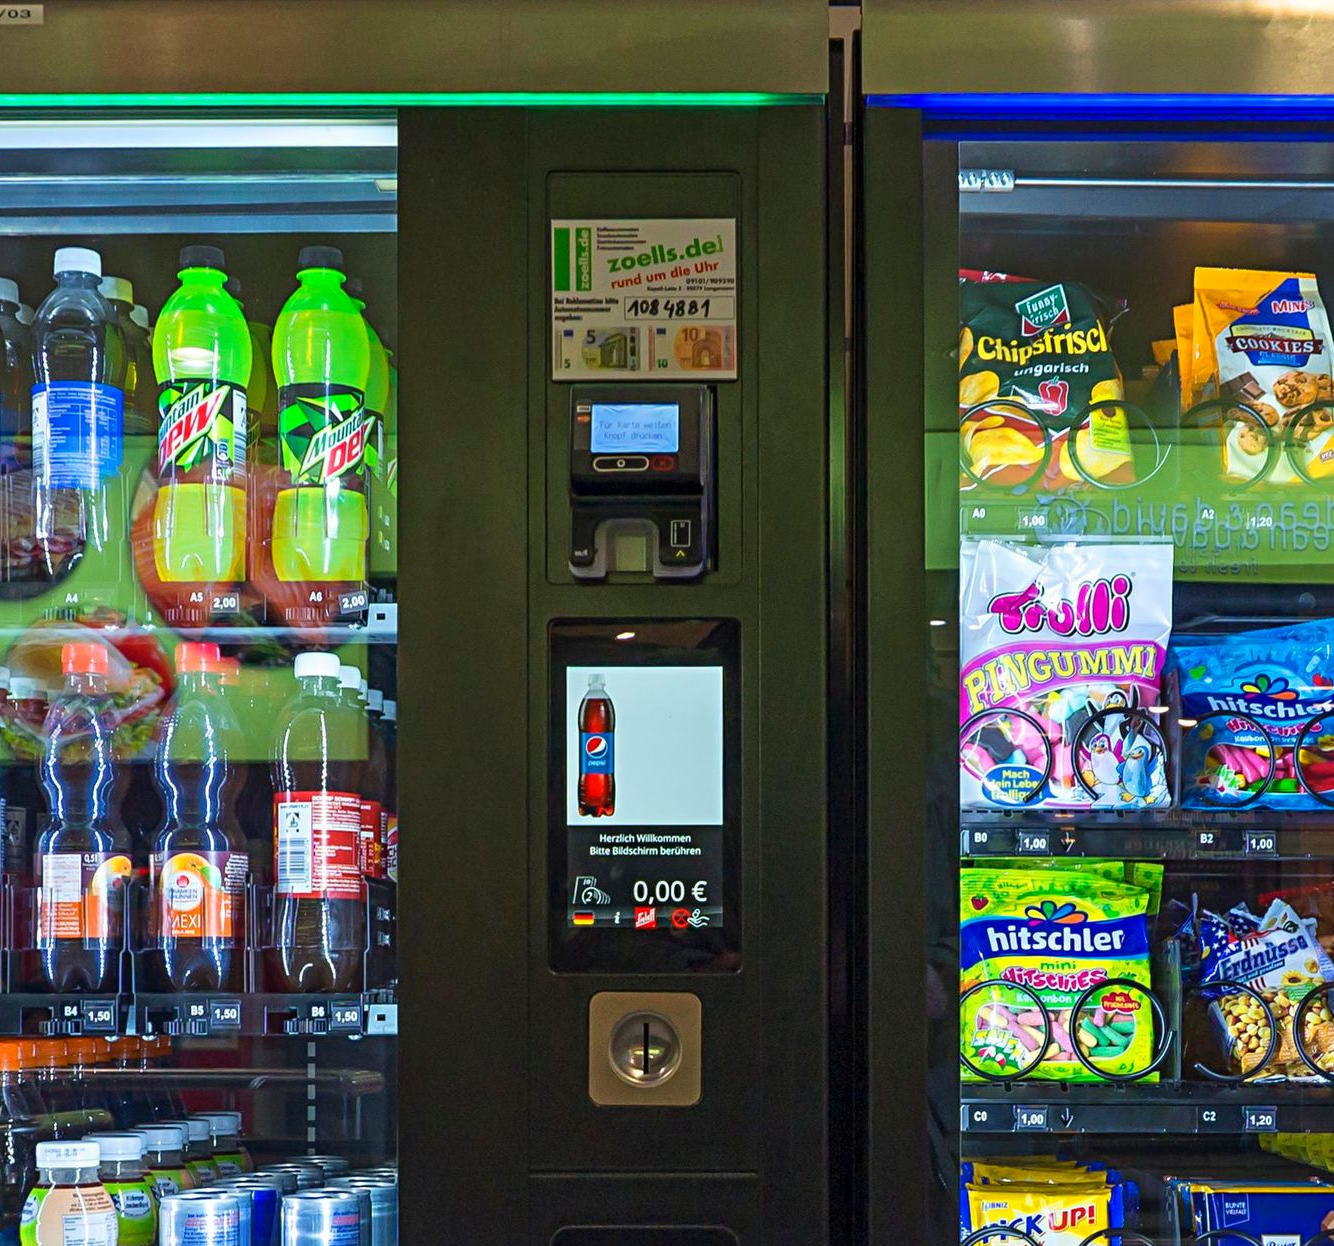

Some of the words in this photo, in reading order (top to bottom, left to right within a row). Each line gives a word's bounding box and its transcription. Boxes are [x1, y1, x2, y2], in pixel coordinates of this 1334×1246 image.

[607, 237, 718, 273] zoells.de
[611, 272, 642, 290] rund
[646, 270, 667, 282] um
[671, 266, 691, 279] die
[695, 260, 719, 273] Uhr
[627, 298, 710, 318] 1084881
[1235, 338, 1315, 353] COOKIES
[1014, 362, 1089, 377] ungarisch
[972, 508, 985, 518] A0
[1023, 515, 1045, 527] 1,00
[987, 573, 1134, 637] Trolli
[965, 646, 1156, 714] PINGUMMI
[1207, 696, 1333, 719] hitschler
[599, 834, 635, 843] Herzlich
[637, 834, 691, 843] Willkommen
[589, 847, 611, 856] Bitte
[613, 847, 659, 856] Bildschirm
[660, 847, 701, 856] berühren
[633, 880, 685, 904] 0,00
[691, 880, 708, 902] €
[987, 926, 1125, 953] hitschler
[1040, 961, 1077, 970] mini
[191, 1006, 203, 1016] B5
[214, 1008, 237, 1020] 1,50
[1225, 1202, 1247, 1210] BUNTE
